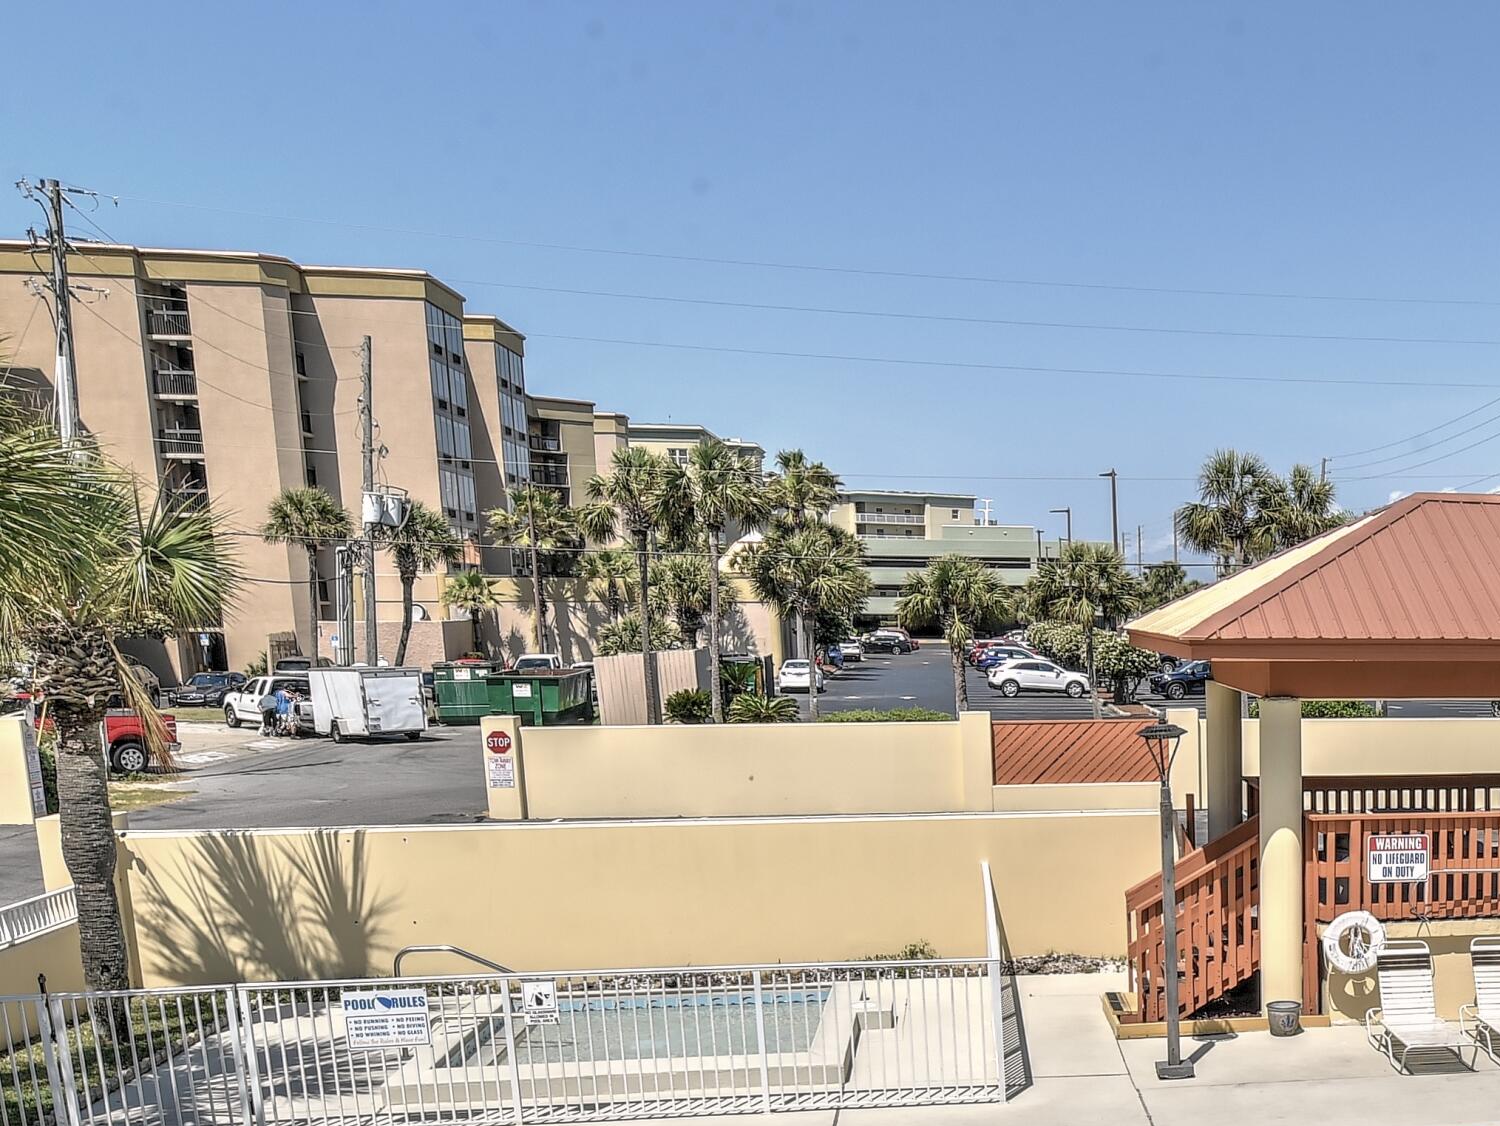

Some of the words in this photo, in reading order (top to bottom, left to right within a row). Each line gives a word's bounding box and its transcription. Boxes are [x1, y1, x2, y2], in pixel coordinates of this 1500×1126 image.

[488, 737, 510, 748] STOP
[1375, 837, 1422, 850] WARNING
[1372, 853, 1382, 865] NO
[1386, 853, 1425, 864] LIFEGUARD
[1382, 866, 1392, 878] ON
[1396, 866, 1414, 877] DUTY
[344, 999, 372, 1010] POOL
[391, 996, 425, 1009] RULES
